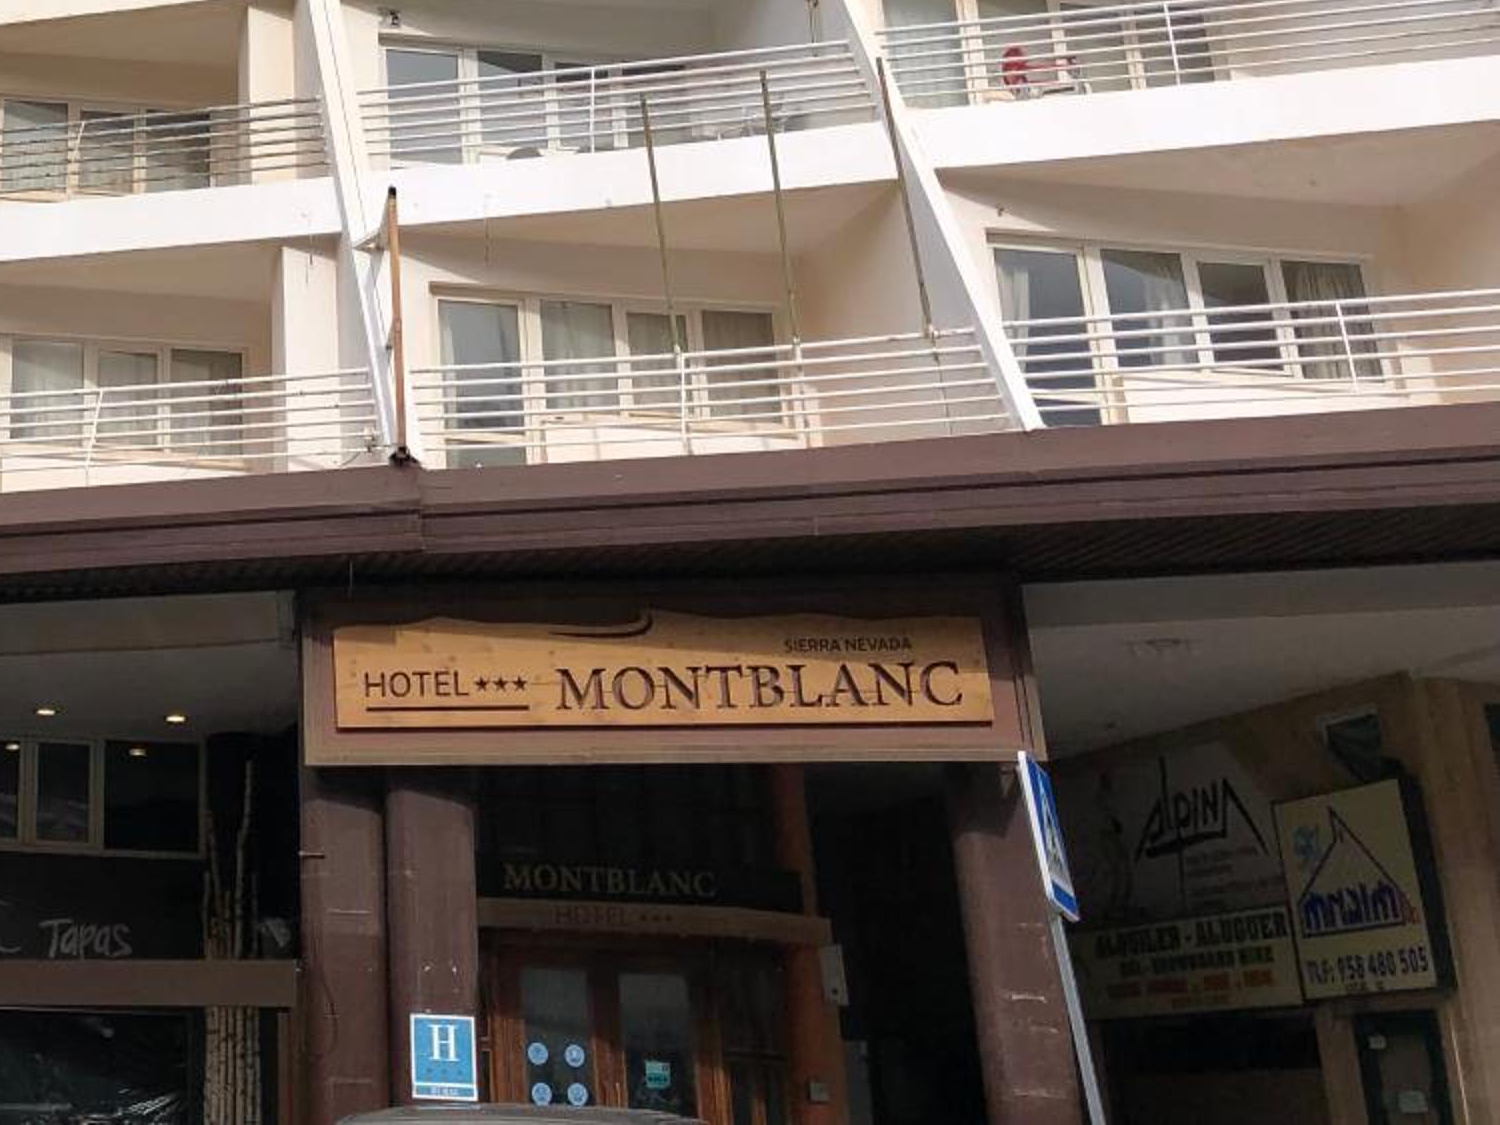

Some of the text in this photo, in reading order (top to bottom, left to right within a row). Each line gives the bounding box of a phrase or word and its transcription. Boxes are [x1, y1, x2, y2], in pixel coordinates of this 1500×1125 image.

[784, 637, 913, 653] SIERRA NEVADA
[364, 660, 963, 710] HOTEL MONTBLANC
[502, 861, 717, 898] MONTBLANC
[427, 1024, 460, 1062] H
